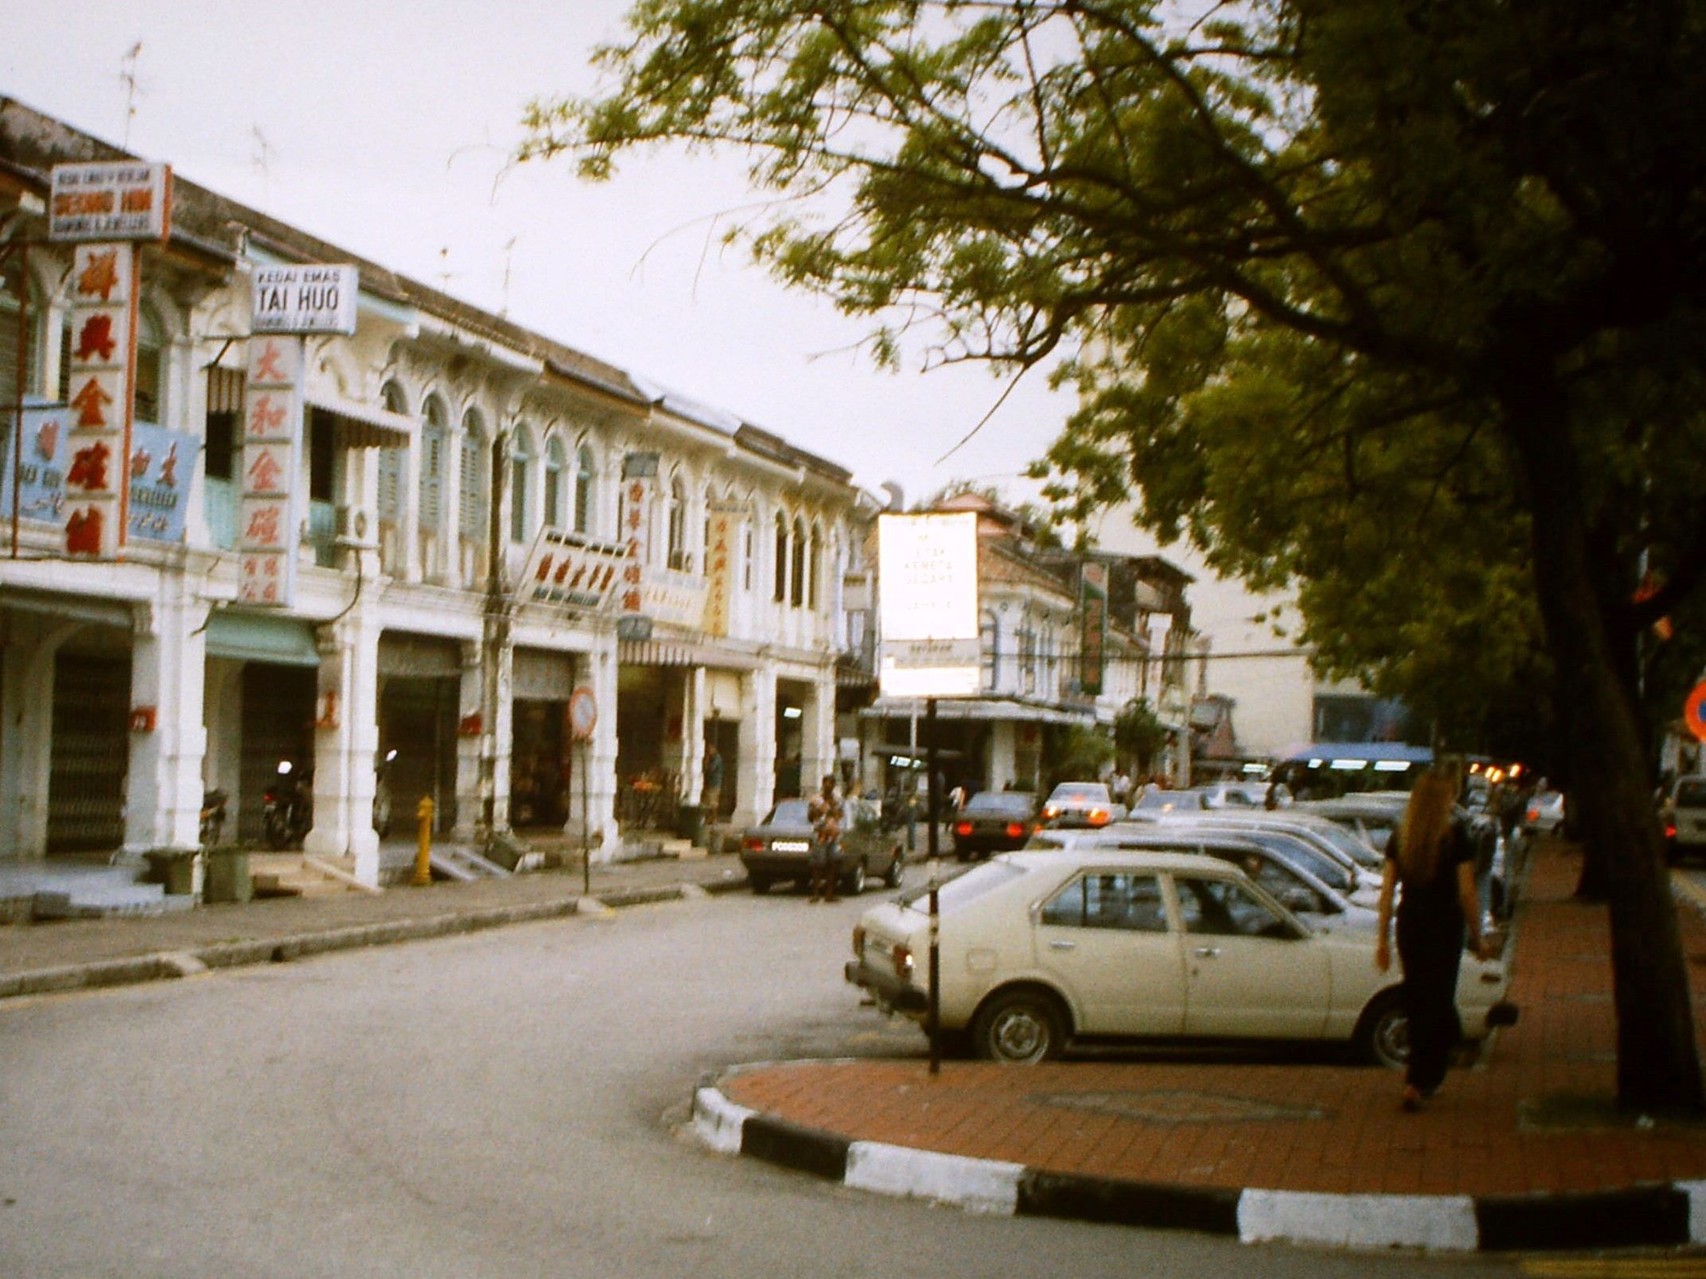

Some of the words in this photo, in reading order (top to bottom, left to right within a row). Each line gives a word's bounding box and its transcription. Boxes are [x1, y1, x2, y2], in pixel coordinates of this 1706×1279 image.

[258, 269, 297, 282] KEDAI
[304, 268, 340, 282] EMAS
[259, 286, 288, 312] TAI
[298, 284, 339, 312] HUO
